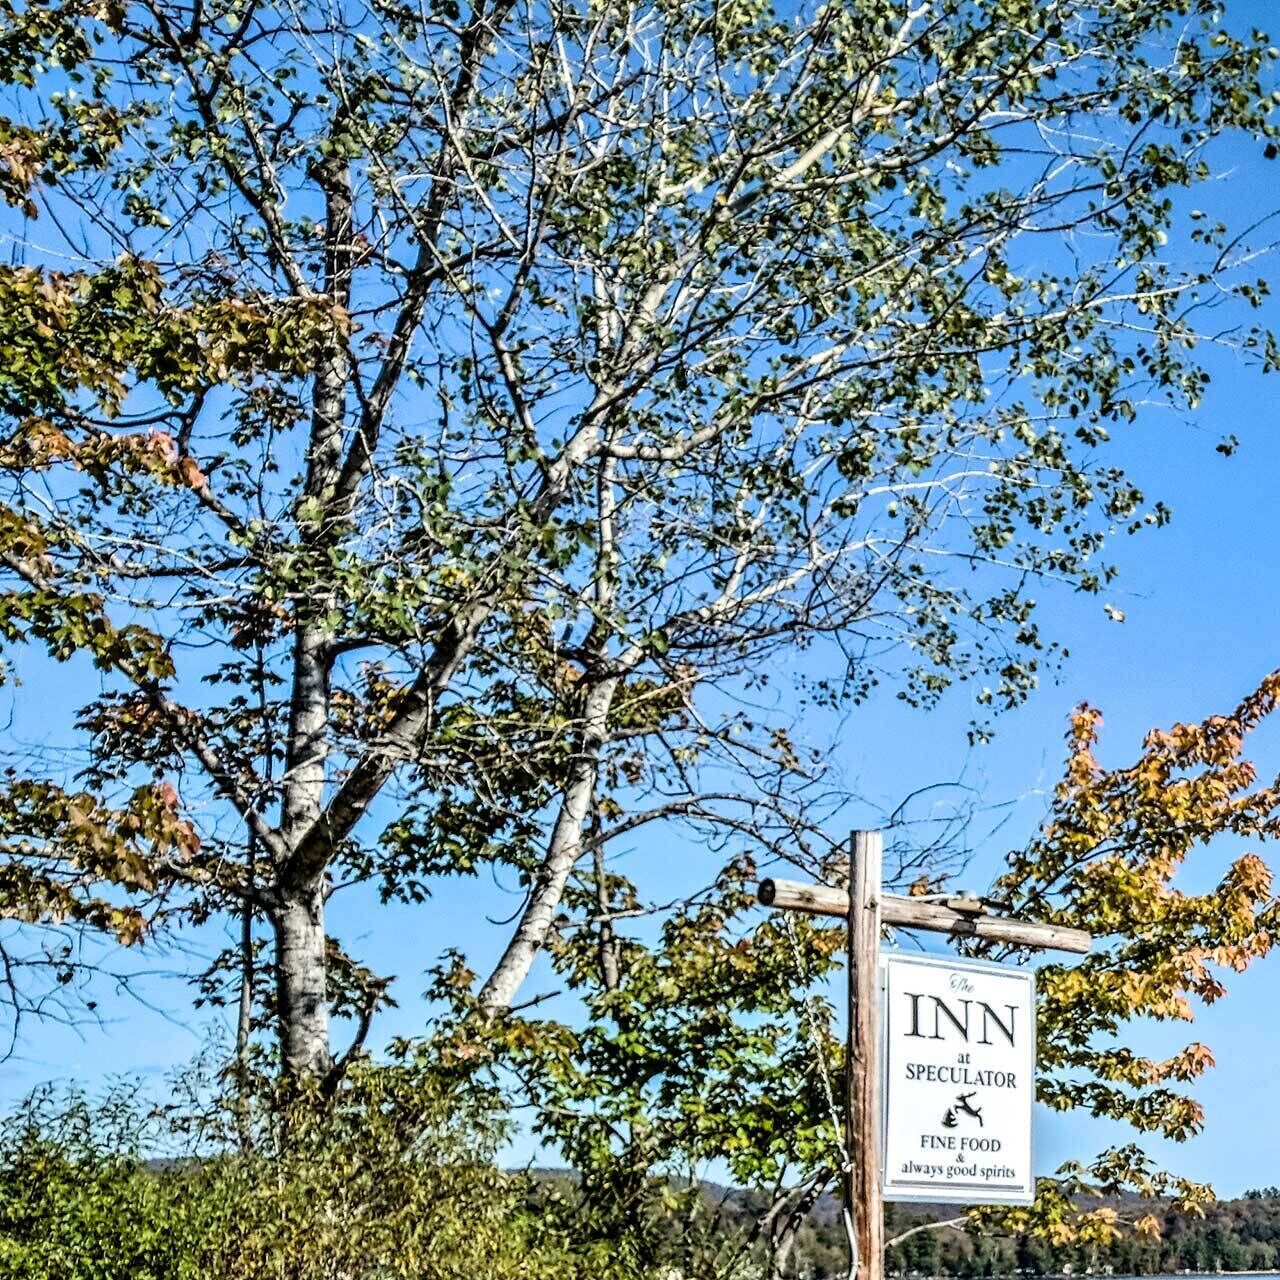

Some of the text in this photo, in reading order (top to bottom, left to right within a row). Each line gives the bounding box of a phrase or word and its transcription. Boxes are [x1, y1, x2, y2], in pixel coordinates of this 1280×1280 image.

[949, 972, 975, 993] The
[904, 992, 1019, 1047] INN
[957, 1052, 971, 1065] at
[905, 1062, 1017, 1089] SPECULATOR
[920, 1134, 1001, 1152] FINE FOOD
[955, 1152, 965, 1163] &
[901, 1160, 1016, 1181] always good spirits
